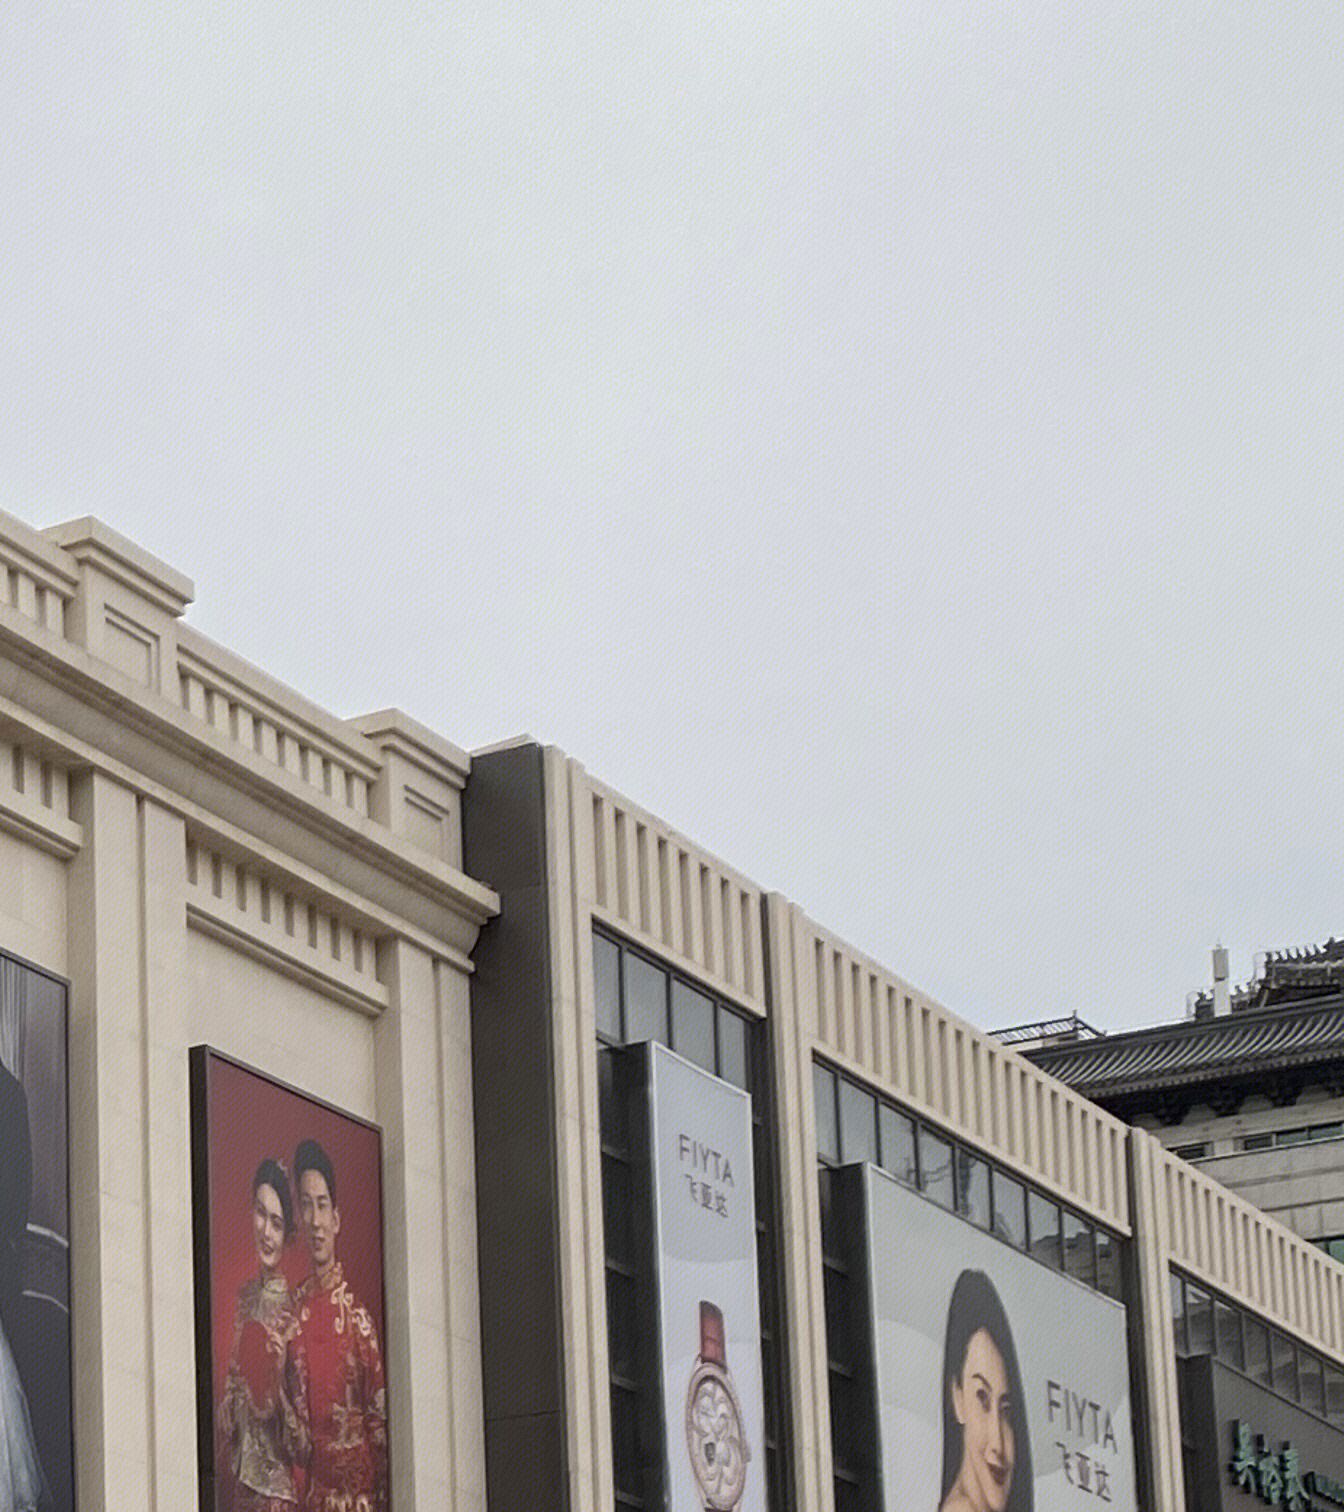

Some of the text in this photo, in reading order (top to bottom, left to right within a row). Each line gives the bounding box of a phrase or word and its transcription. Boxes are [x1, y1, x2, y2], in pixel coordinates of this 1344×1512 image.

[679, 1133, 734, 1188] FIYTA
[685, 1173, 728, 1218] 飞亚达
[1047, 1380, 1118, 1454] FIYTA
[1056, 1441, 1111, 1502] 飞亚达
